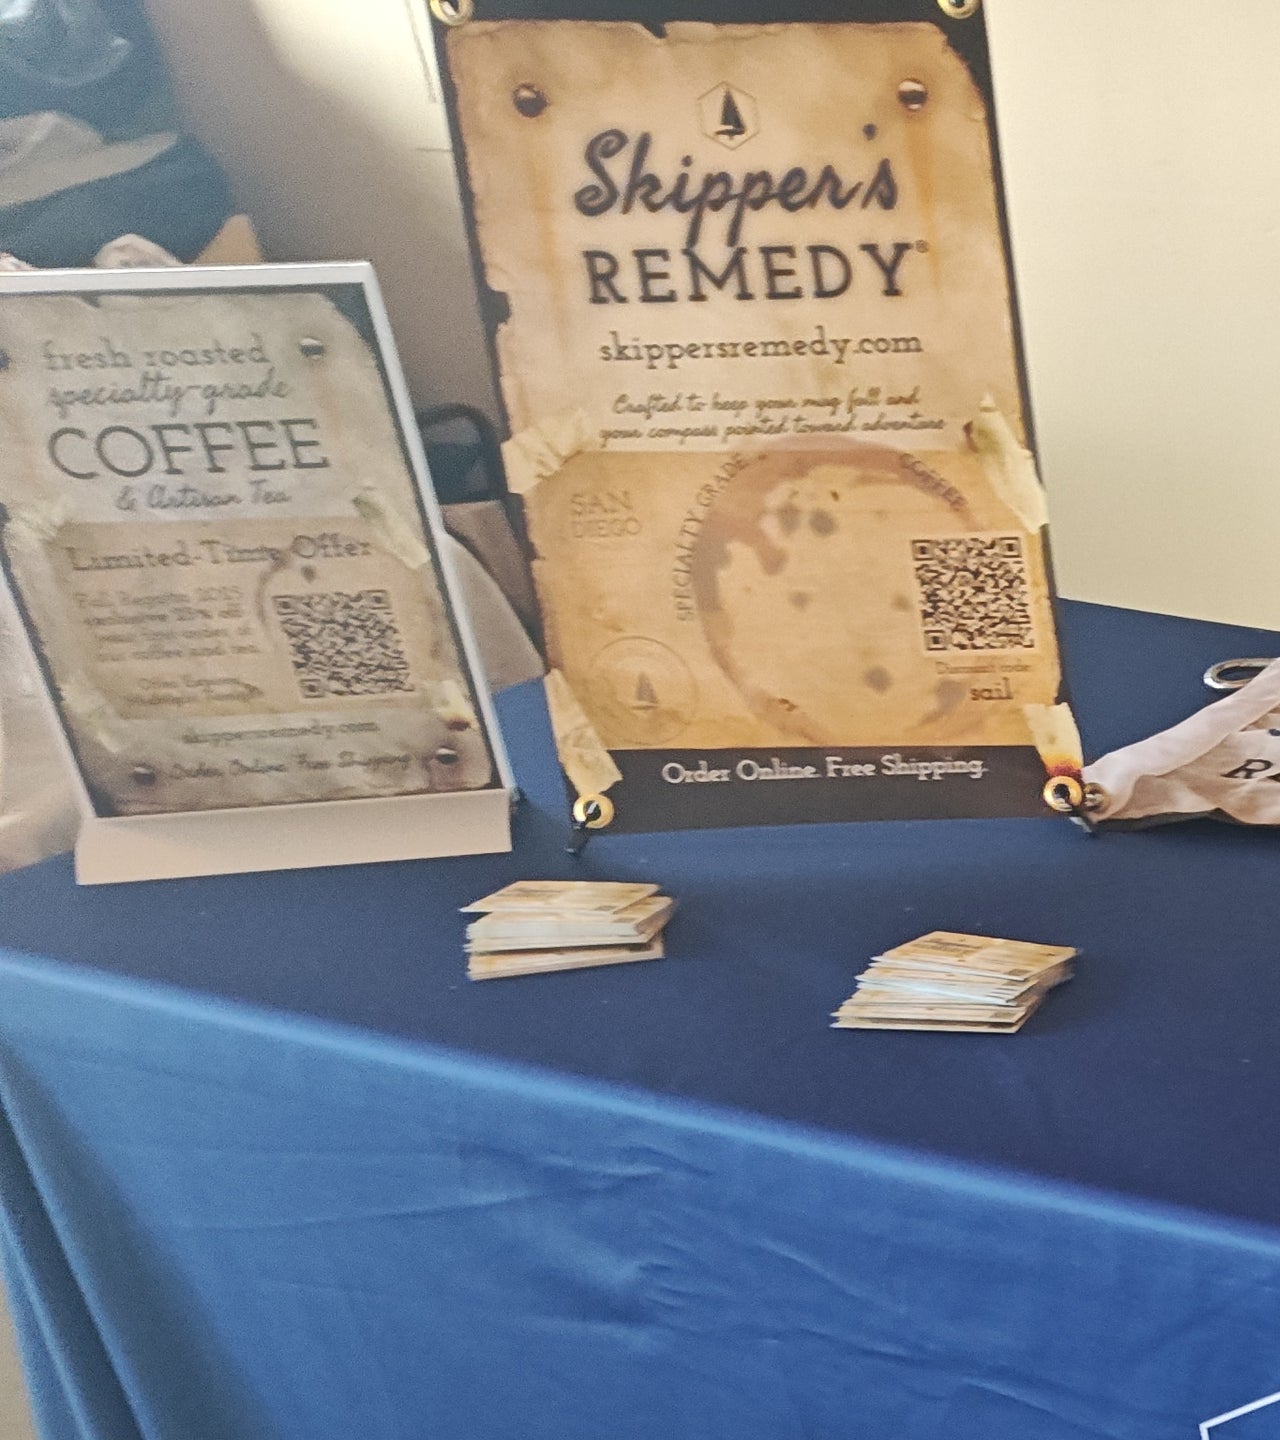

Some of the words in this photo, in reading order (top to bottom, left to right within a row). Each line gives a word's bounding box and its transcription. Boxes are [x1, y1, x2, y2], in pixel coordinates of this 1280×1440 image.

[573, 122, 899, 248] Skipper's
[43, 335, 132, 371] fresh
[145, 332, 272, 366] roasted
[600, 325, 925, 371] skippersremedy.com
[612, 391, 684, 420] Crafted
[686, 392, 707, 412] to
[711, 391, 749, 418] keep
[755, 398, 798, 419] your
[801, 397, 840, 417] mug
[49, 417, 331, 480] COFFEE
[600, 428, 643, 449] your
[722, 415, 790, 443] pointed
[970, 676, 1014, 701] sail
[661, 759, 732, 785] Order
[825, 755, 876, 778] Free
